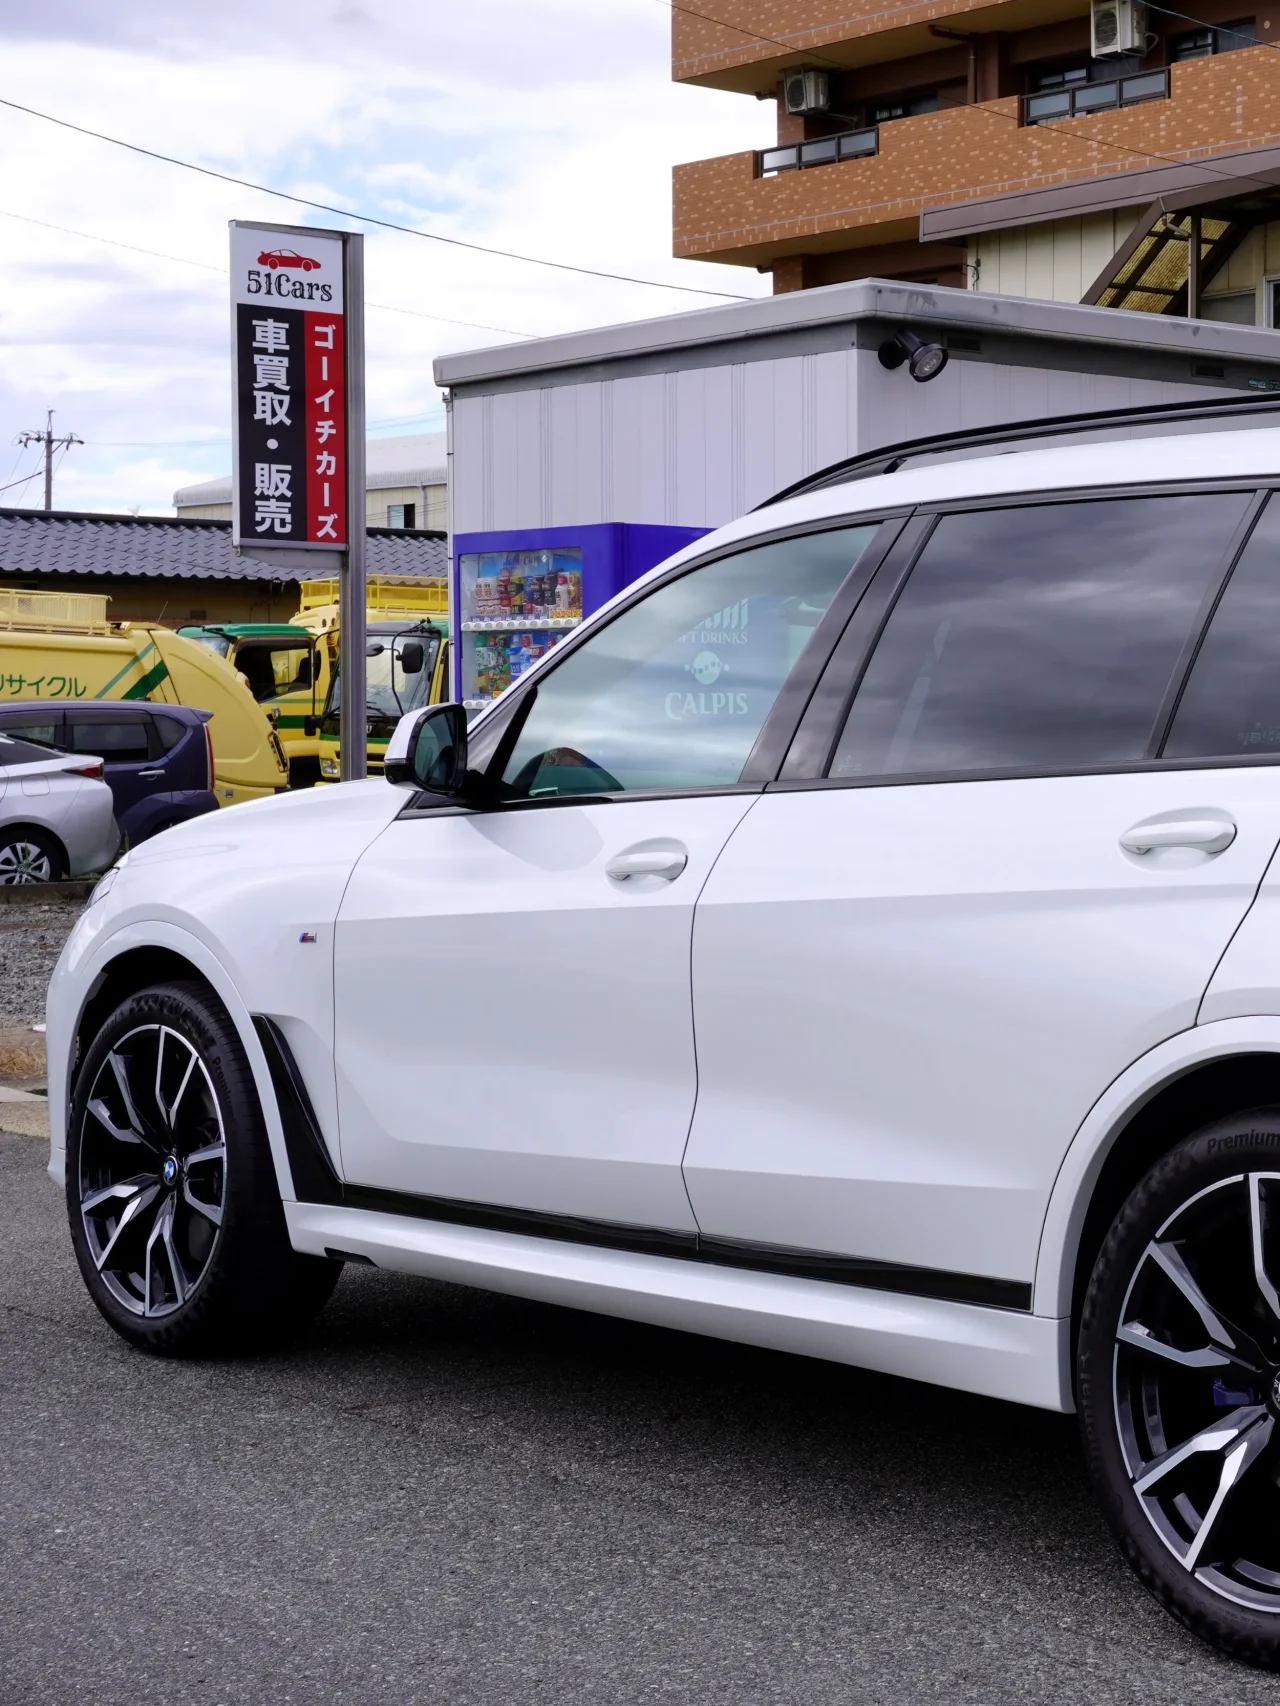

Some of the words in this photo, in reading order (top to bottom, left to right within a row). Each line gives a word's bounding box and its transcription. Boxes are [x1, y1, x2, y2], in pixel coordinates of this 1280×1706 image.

[247, 270, 332, 301] 51Cars
[252, 318, 292, 534] 車買取・販売
[314, 324, 339, 538] ゴーイチカーズ
[701, 631, 748, 643] DRINKS
[664, 692, 748, 720] CALPIS
